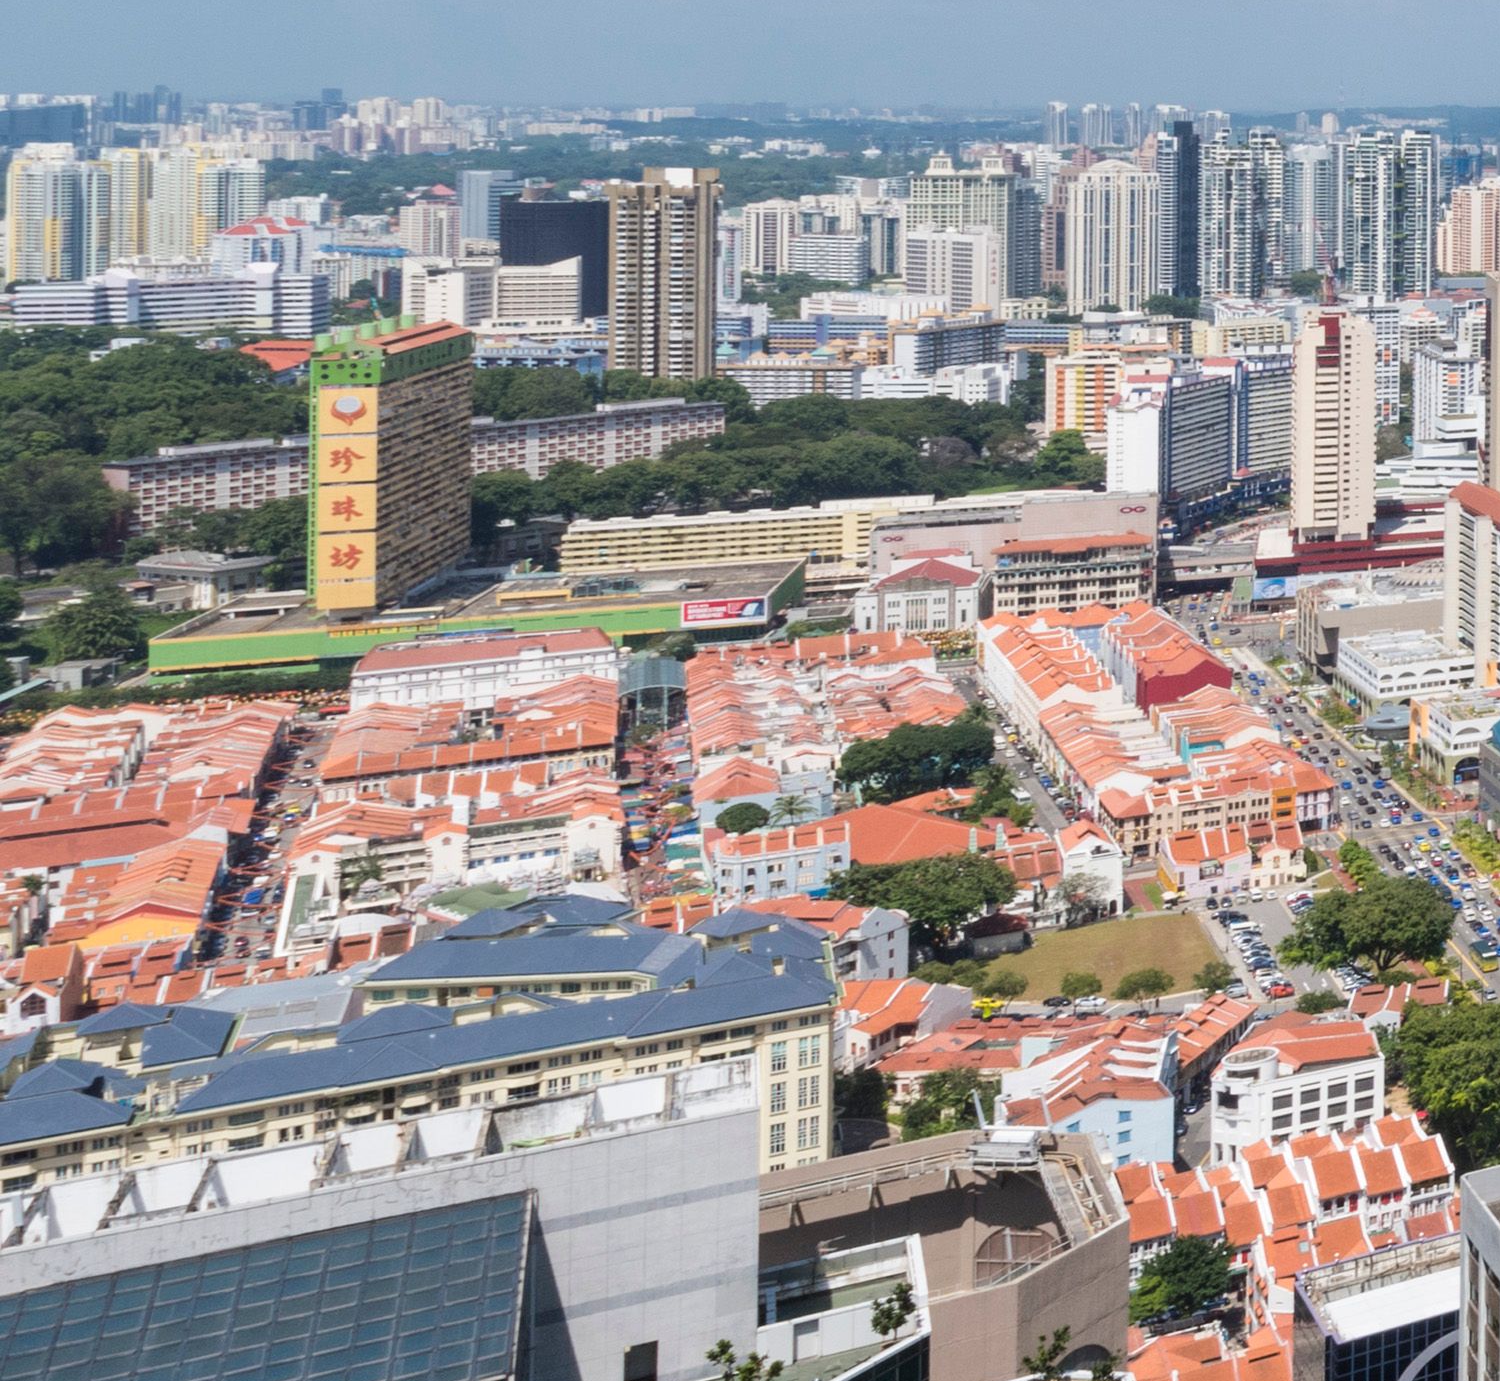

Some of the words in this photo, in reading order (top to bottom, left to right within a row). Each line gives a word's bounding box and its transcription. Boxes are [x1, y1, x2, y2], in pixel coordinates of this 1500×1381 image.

[329, 445, 367, 571] 珍珠坊
[1119, 505, 1147, 514] OG
